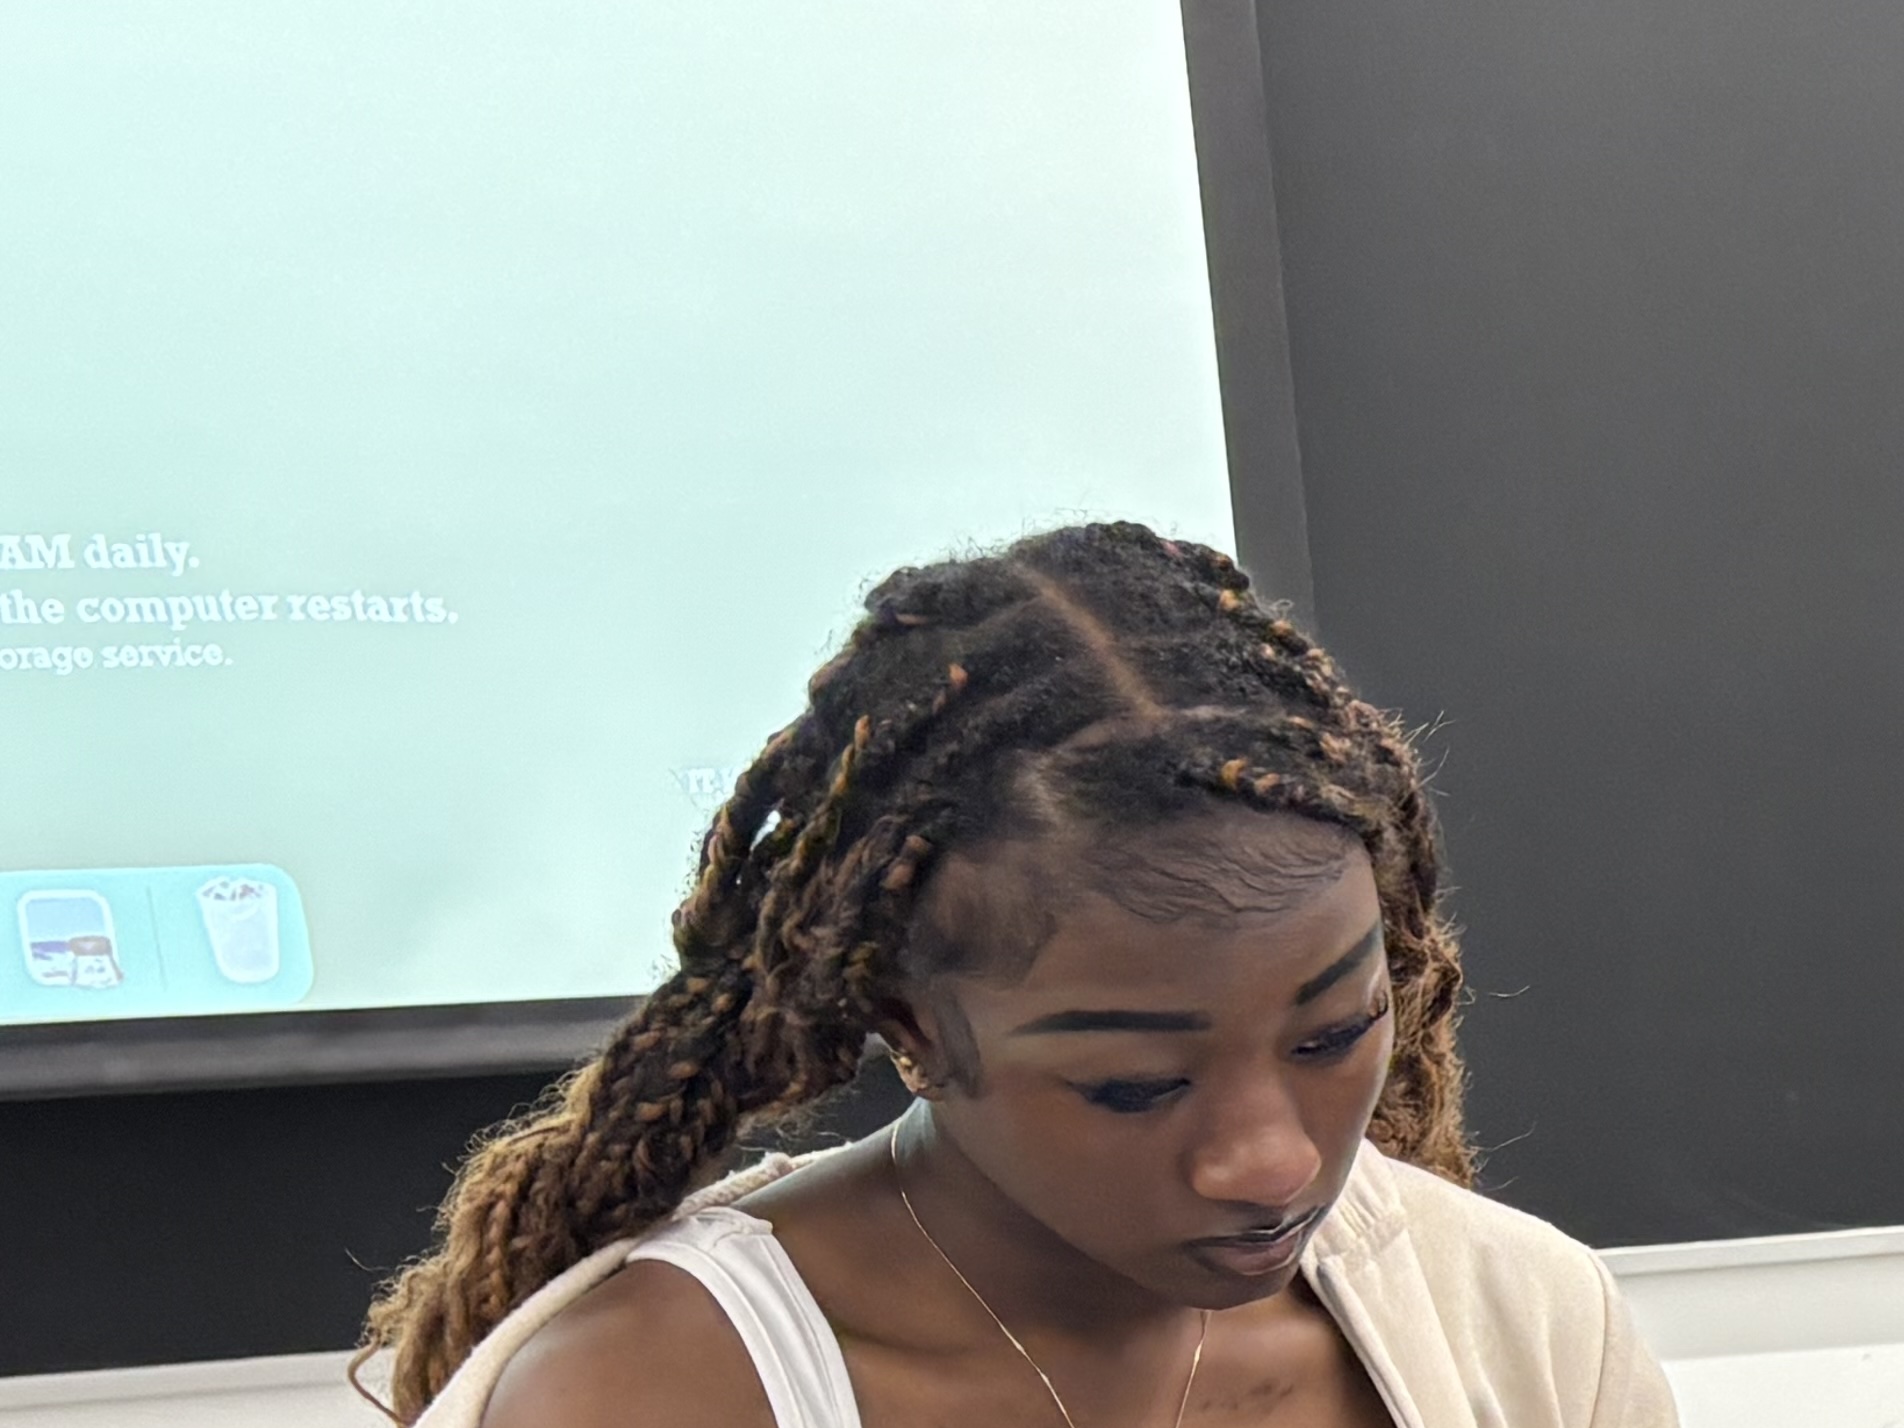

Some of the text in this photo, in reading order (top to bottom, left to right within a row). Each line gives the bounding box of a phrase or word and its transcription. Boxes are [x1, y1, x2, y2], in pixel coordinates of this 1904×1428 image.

[0, 532, 199, 577] AM daily.
[76, 587, 276, 631] computer
[286, 588, 458, 623] restarts.
[101, 637, 233, 668] service.
